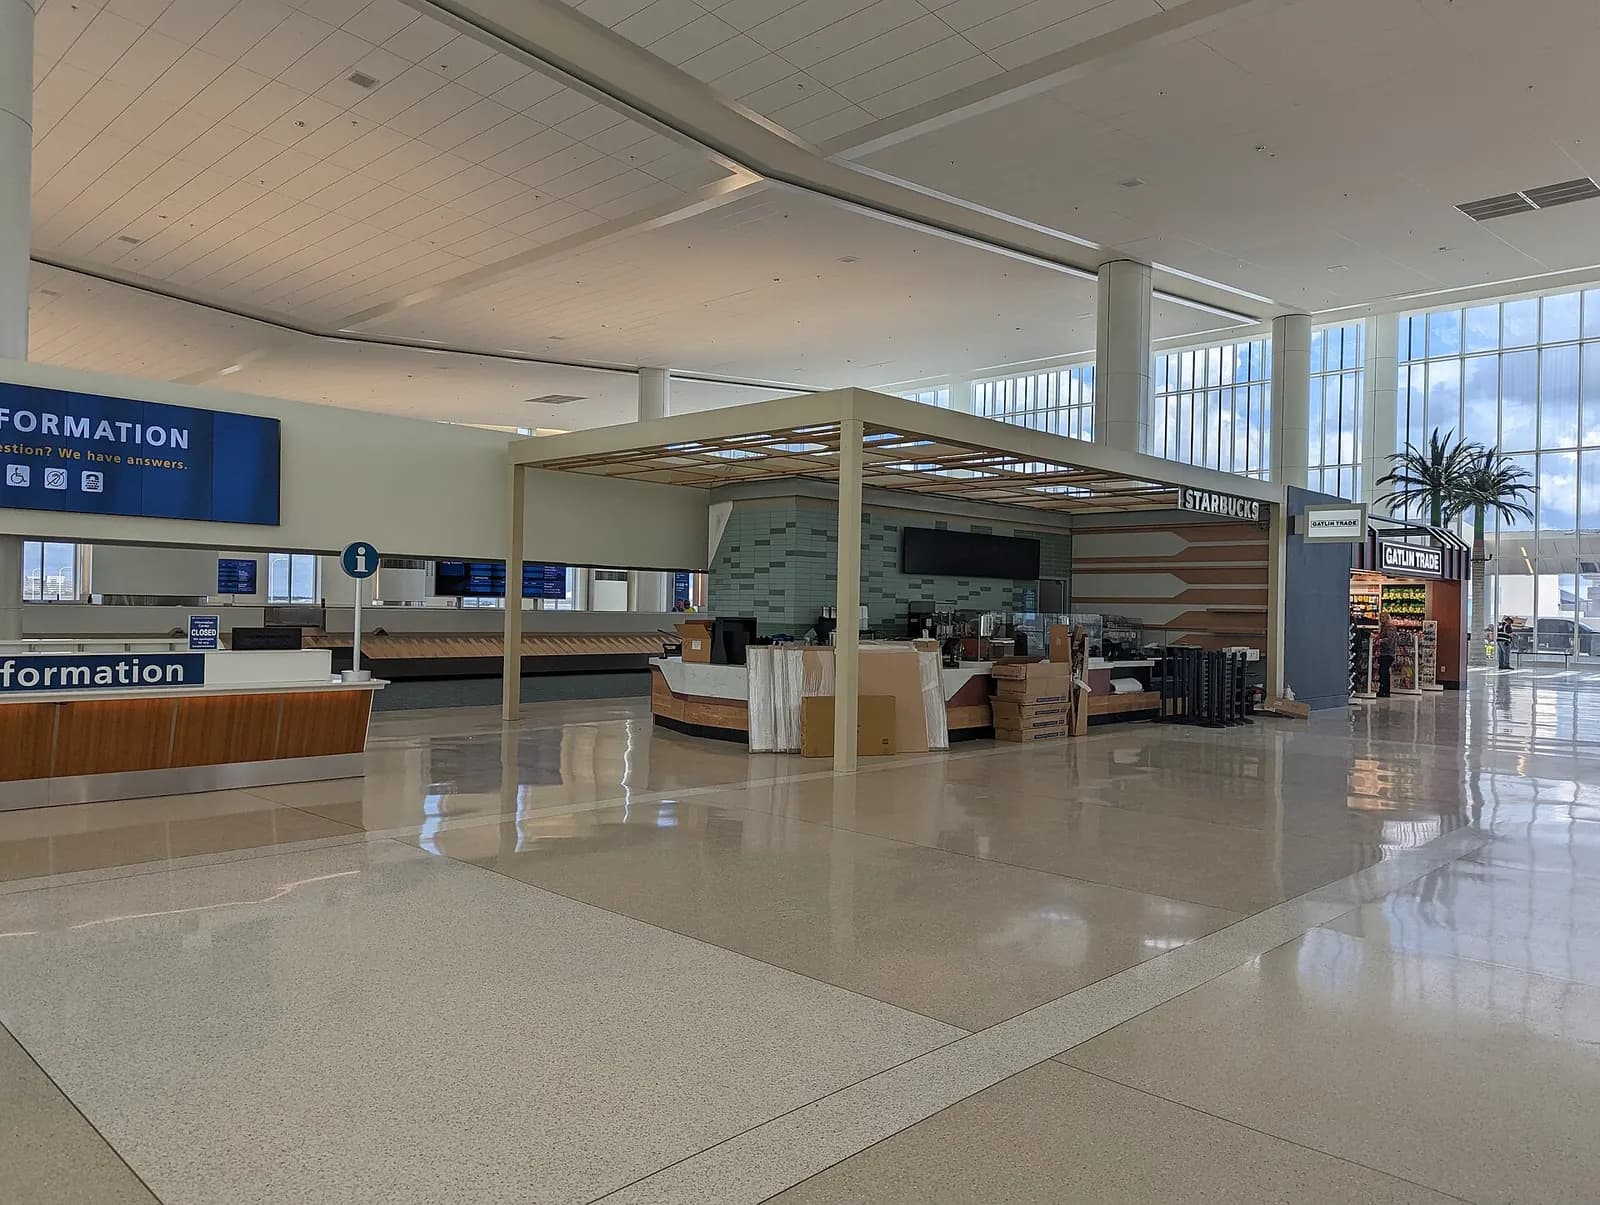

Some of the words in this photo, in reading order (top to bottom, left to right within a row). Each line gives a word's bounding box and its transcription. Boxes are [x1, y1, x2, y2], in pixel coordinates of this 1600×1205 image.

[0, 408, 189, 449] FORMATION
[58, 447, 81, 460] We
[87, 449, 121, 463] have
[127, 456, 188, 470] answers.
[1185, 489, 1259, 519] STARBUCKS
[1386, 547, 1415, 567] GATLIN
[1415, 552, 1440, 570] TRADE
[191, 628, 217, 637] CLOSED
[0, 658, 184, 687] formation
